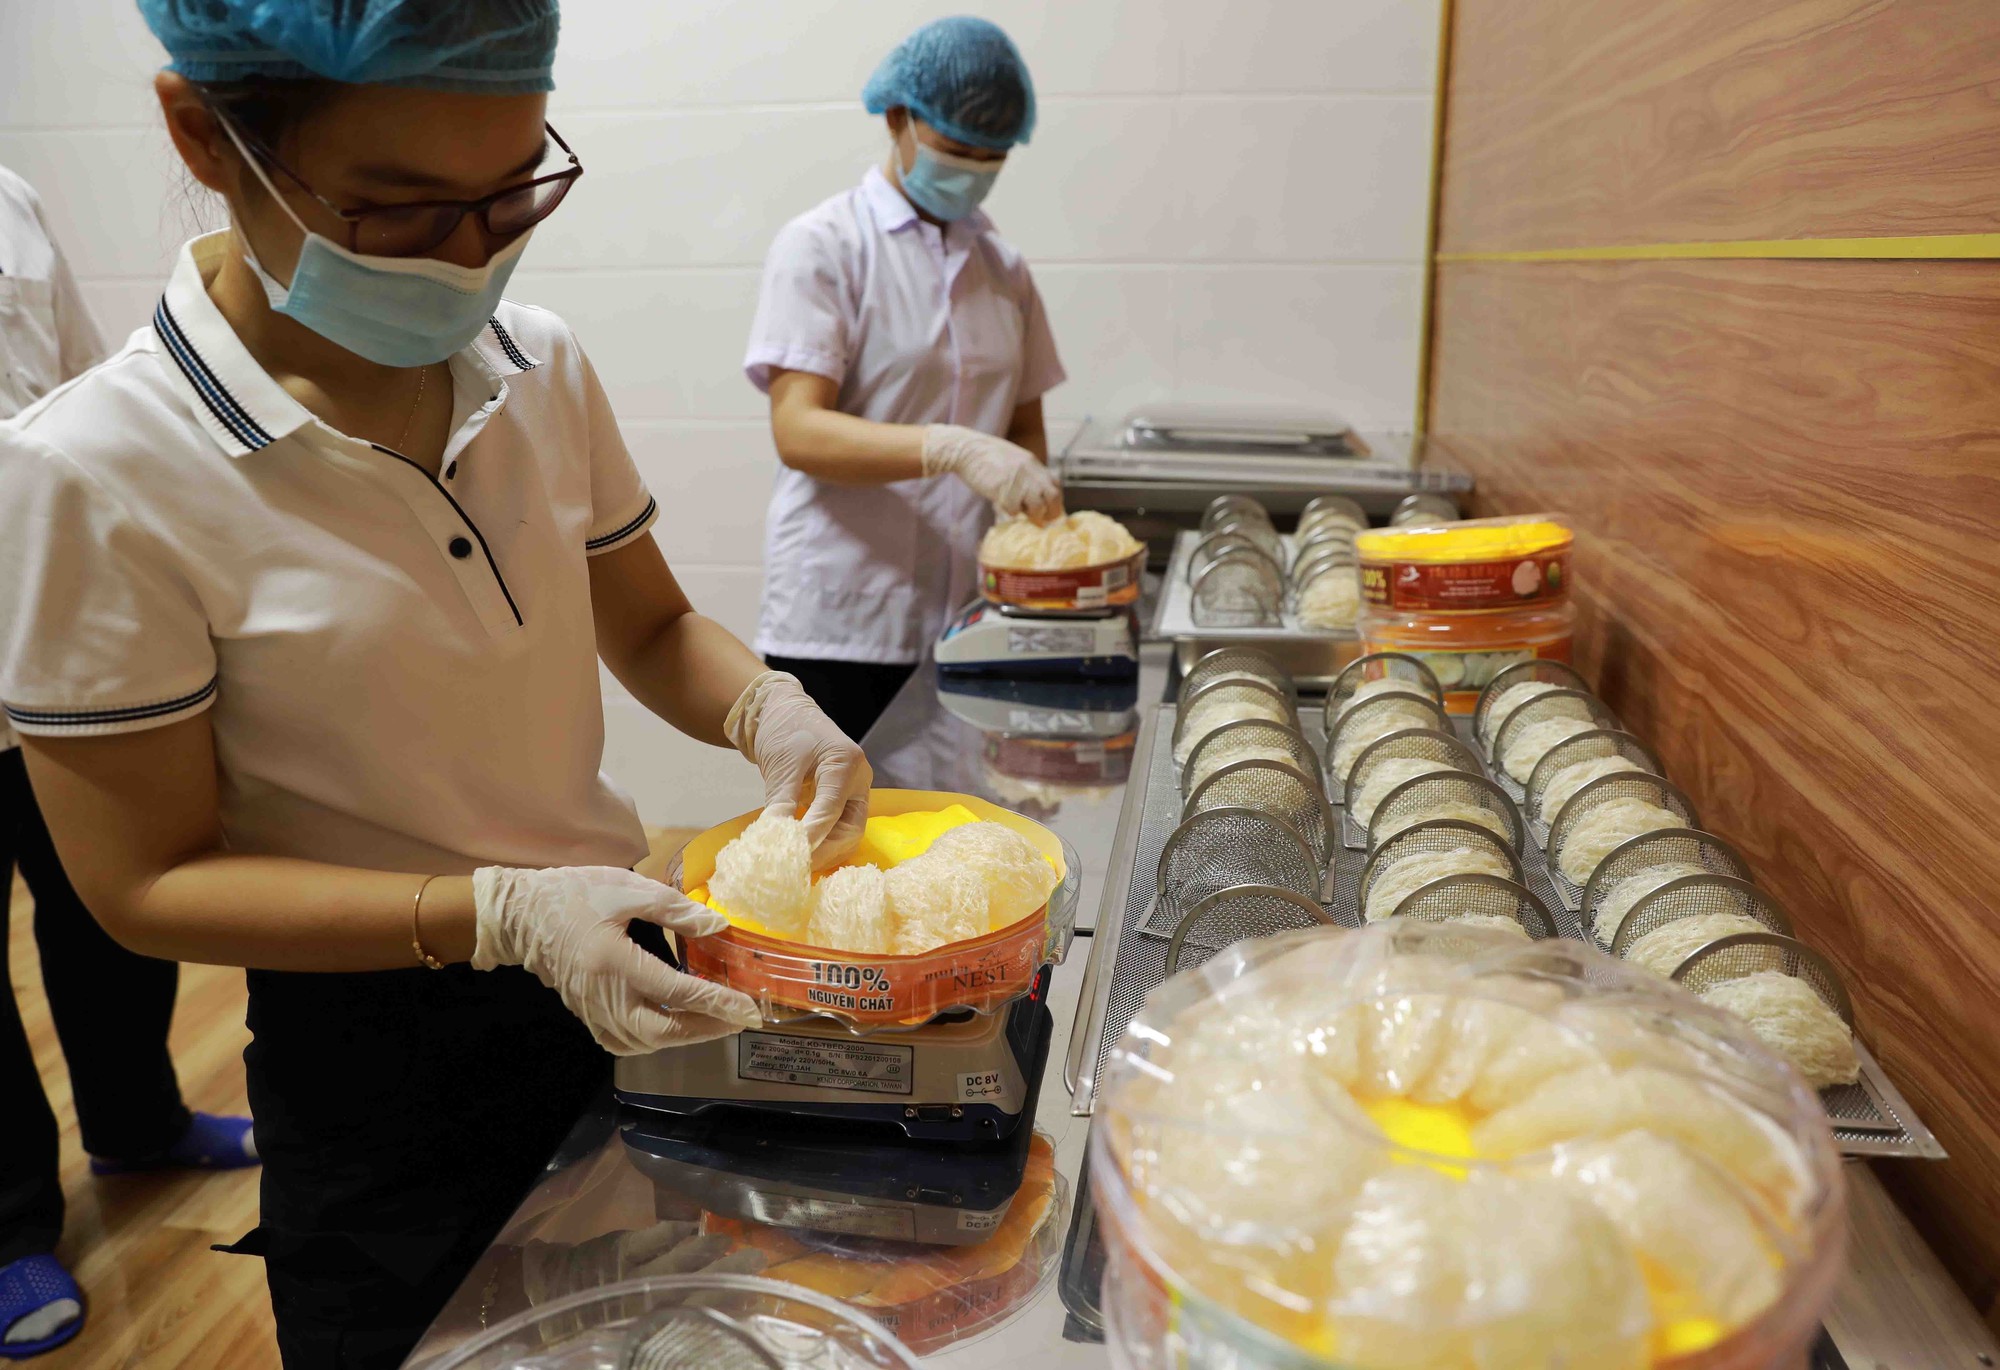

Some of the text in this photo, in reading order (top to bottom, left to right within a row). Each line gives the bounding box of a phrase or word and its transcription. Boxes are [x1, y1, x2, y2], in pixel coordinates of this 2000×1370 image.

[809, 963, 890, 993] 100%
[953, 962, 1009, 992] NEST
[808, 989, 894, 1011] NGUYÊN CHẤT
[779, 1038, 805, 1047] Model:
[773, 1055, 797, 1064] supply
[828, 1067, 839, 1075] DC
[966, 1074, 999, 1086] DC 8V
[881, 1082, 902, 1090] TAIWAN
